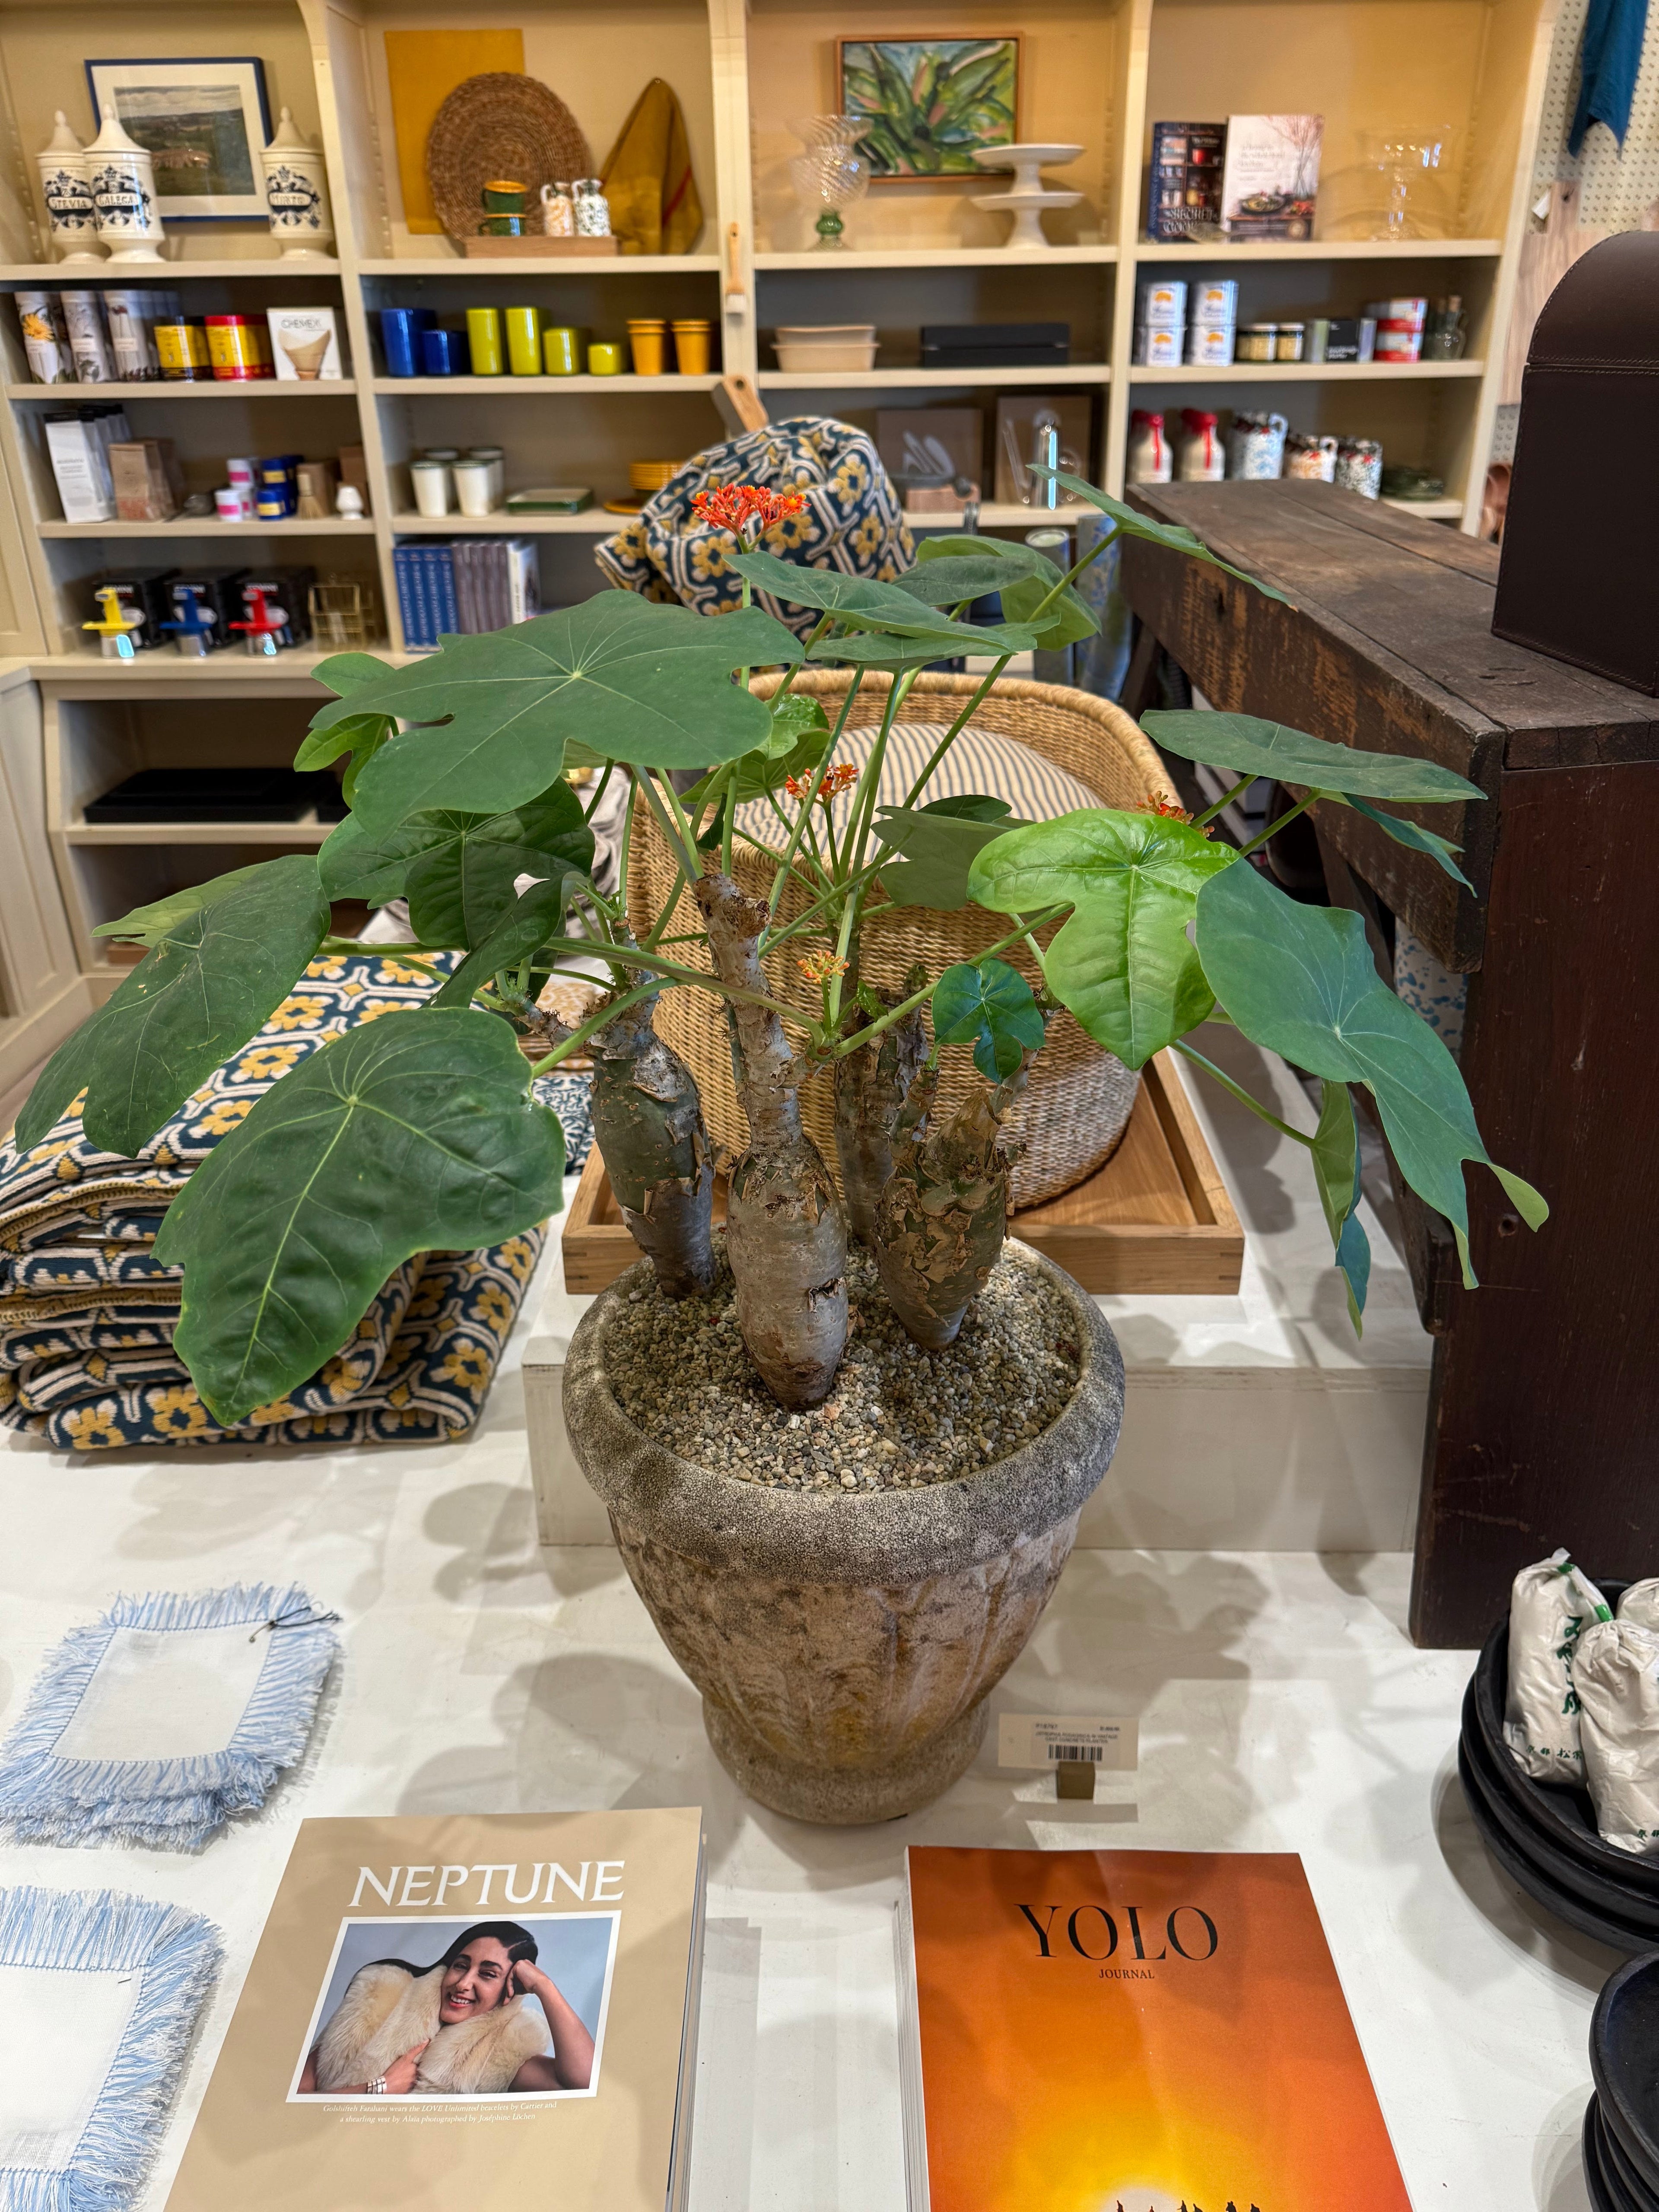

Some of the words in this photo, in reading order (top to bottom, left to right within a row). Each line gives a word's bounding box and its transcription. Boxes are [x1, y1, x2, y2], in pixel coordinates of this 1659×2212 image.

[346, 1860, 625, 1907] NEPTUNE
[1014, 1904, 1218, 1961] YOLO
[1099, 1968, 1155, 1979] JOURNAL
[511, 2103, 519, 2111] by
[346, 2115, 375, 2123] shearling
[392, 2115, 400, 2123] by
[421, 2115, 467, 2124] photographed
[469, 2114, 477, 2123] by
[477, 2114, 510, 2123] Joséphine
